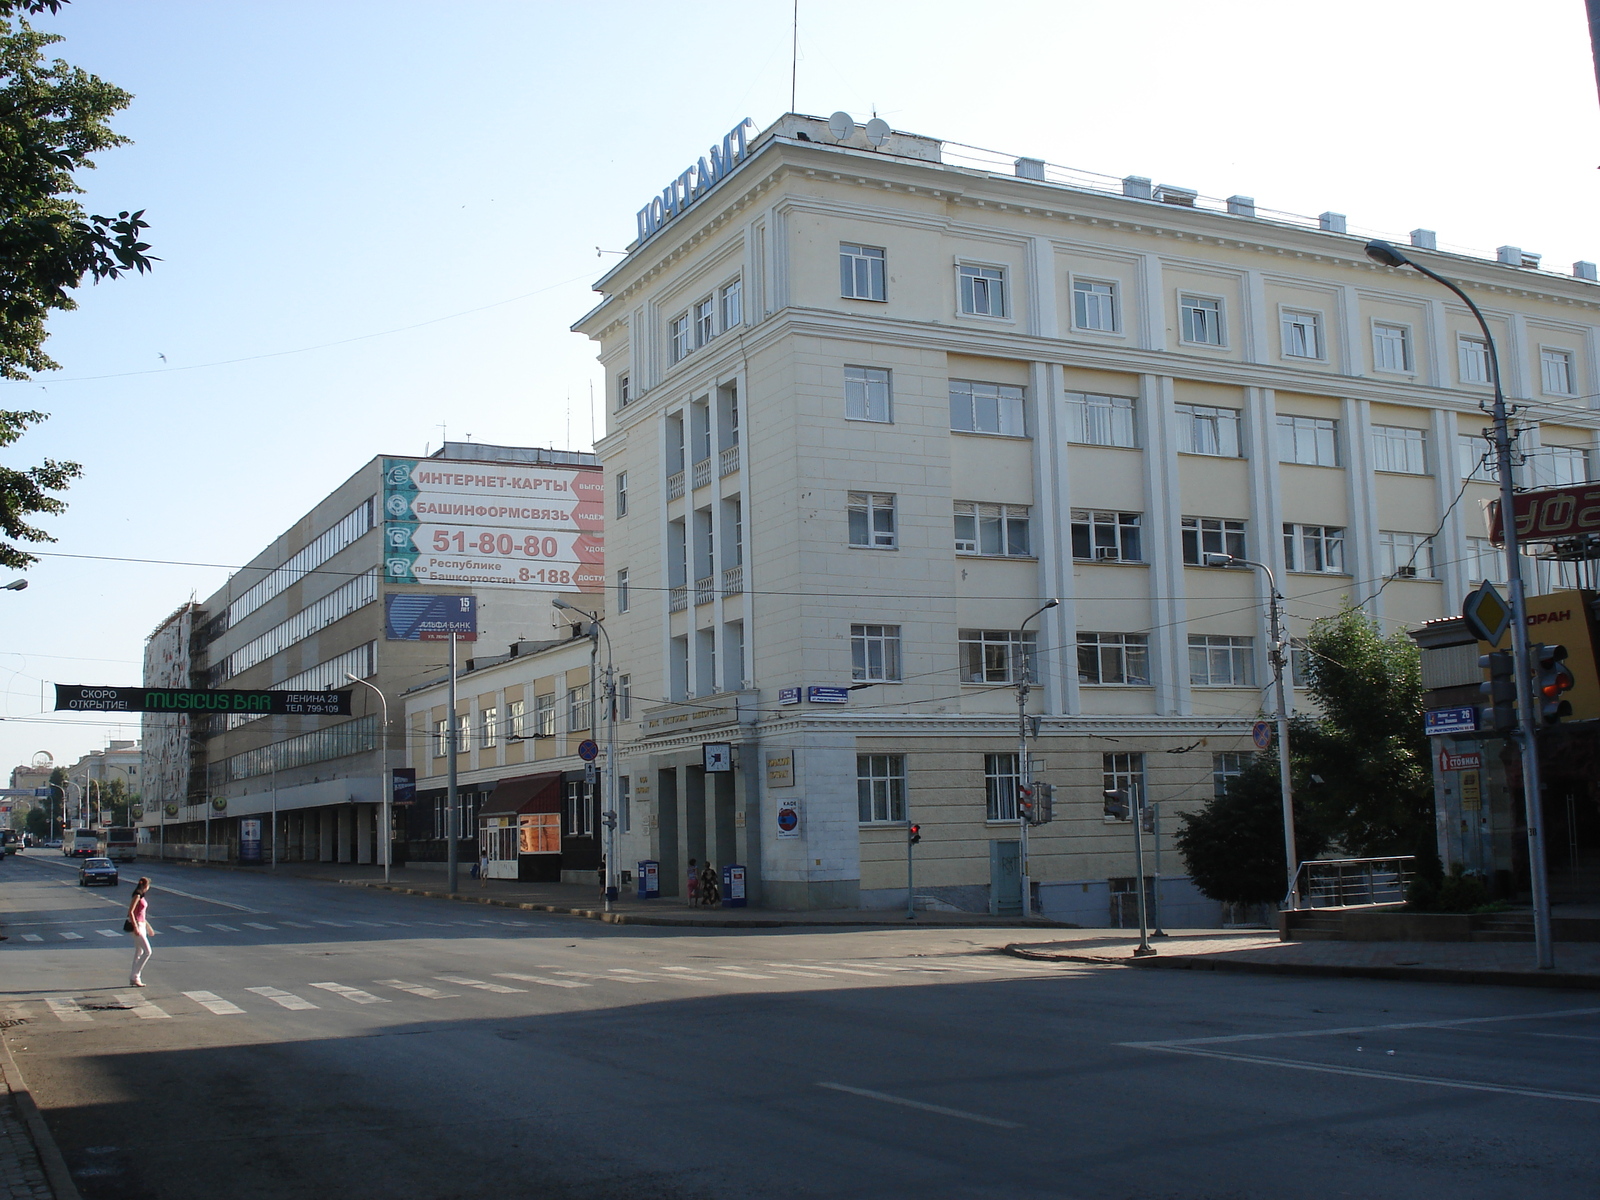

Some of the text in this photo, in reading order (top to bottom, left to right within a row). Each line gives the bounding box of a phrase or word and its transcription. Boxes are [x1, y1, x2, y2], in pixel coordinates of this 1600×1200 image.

[637, 117, 751, 245] ПОЧТАМТ
[418, 471, 568, 492] ИНТЕРНЕТ-КАРТЫ
[416, 502, 570, 521] БАШИНФОРМСВЯЗЬ
[432, 529, 558, 558] 51-80-80
[584, 545, 605, 553] УДОБ
[414, 565, 428, 574] по
[429, 558, 502, 571] Республике
[429, 571, 516, 585] Башкортостан
[518, 567, 571, 584] 8-188
[577, 574, 605, 582] ДОСТУ
[459, 597, 470, 607] 15
[1526, 609, 1571, 626] ОРАН
[80, 689, 117, 699] СКОРО
[286, 694, 338, 703] ЛЕНИНА 28
[69, 699, 128, 709] ОТКРЫТИЕ!
[145, 692, 271, 710] MUSICUS BAR
[285, 704, 339, 713] ТЕЛ. 799-109
[1461, 709, 1470, 719] 26
[1449, 756, 1480, 767] СТОЯНКА
